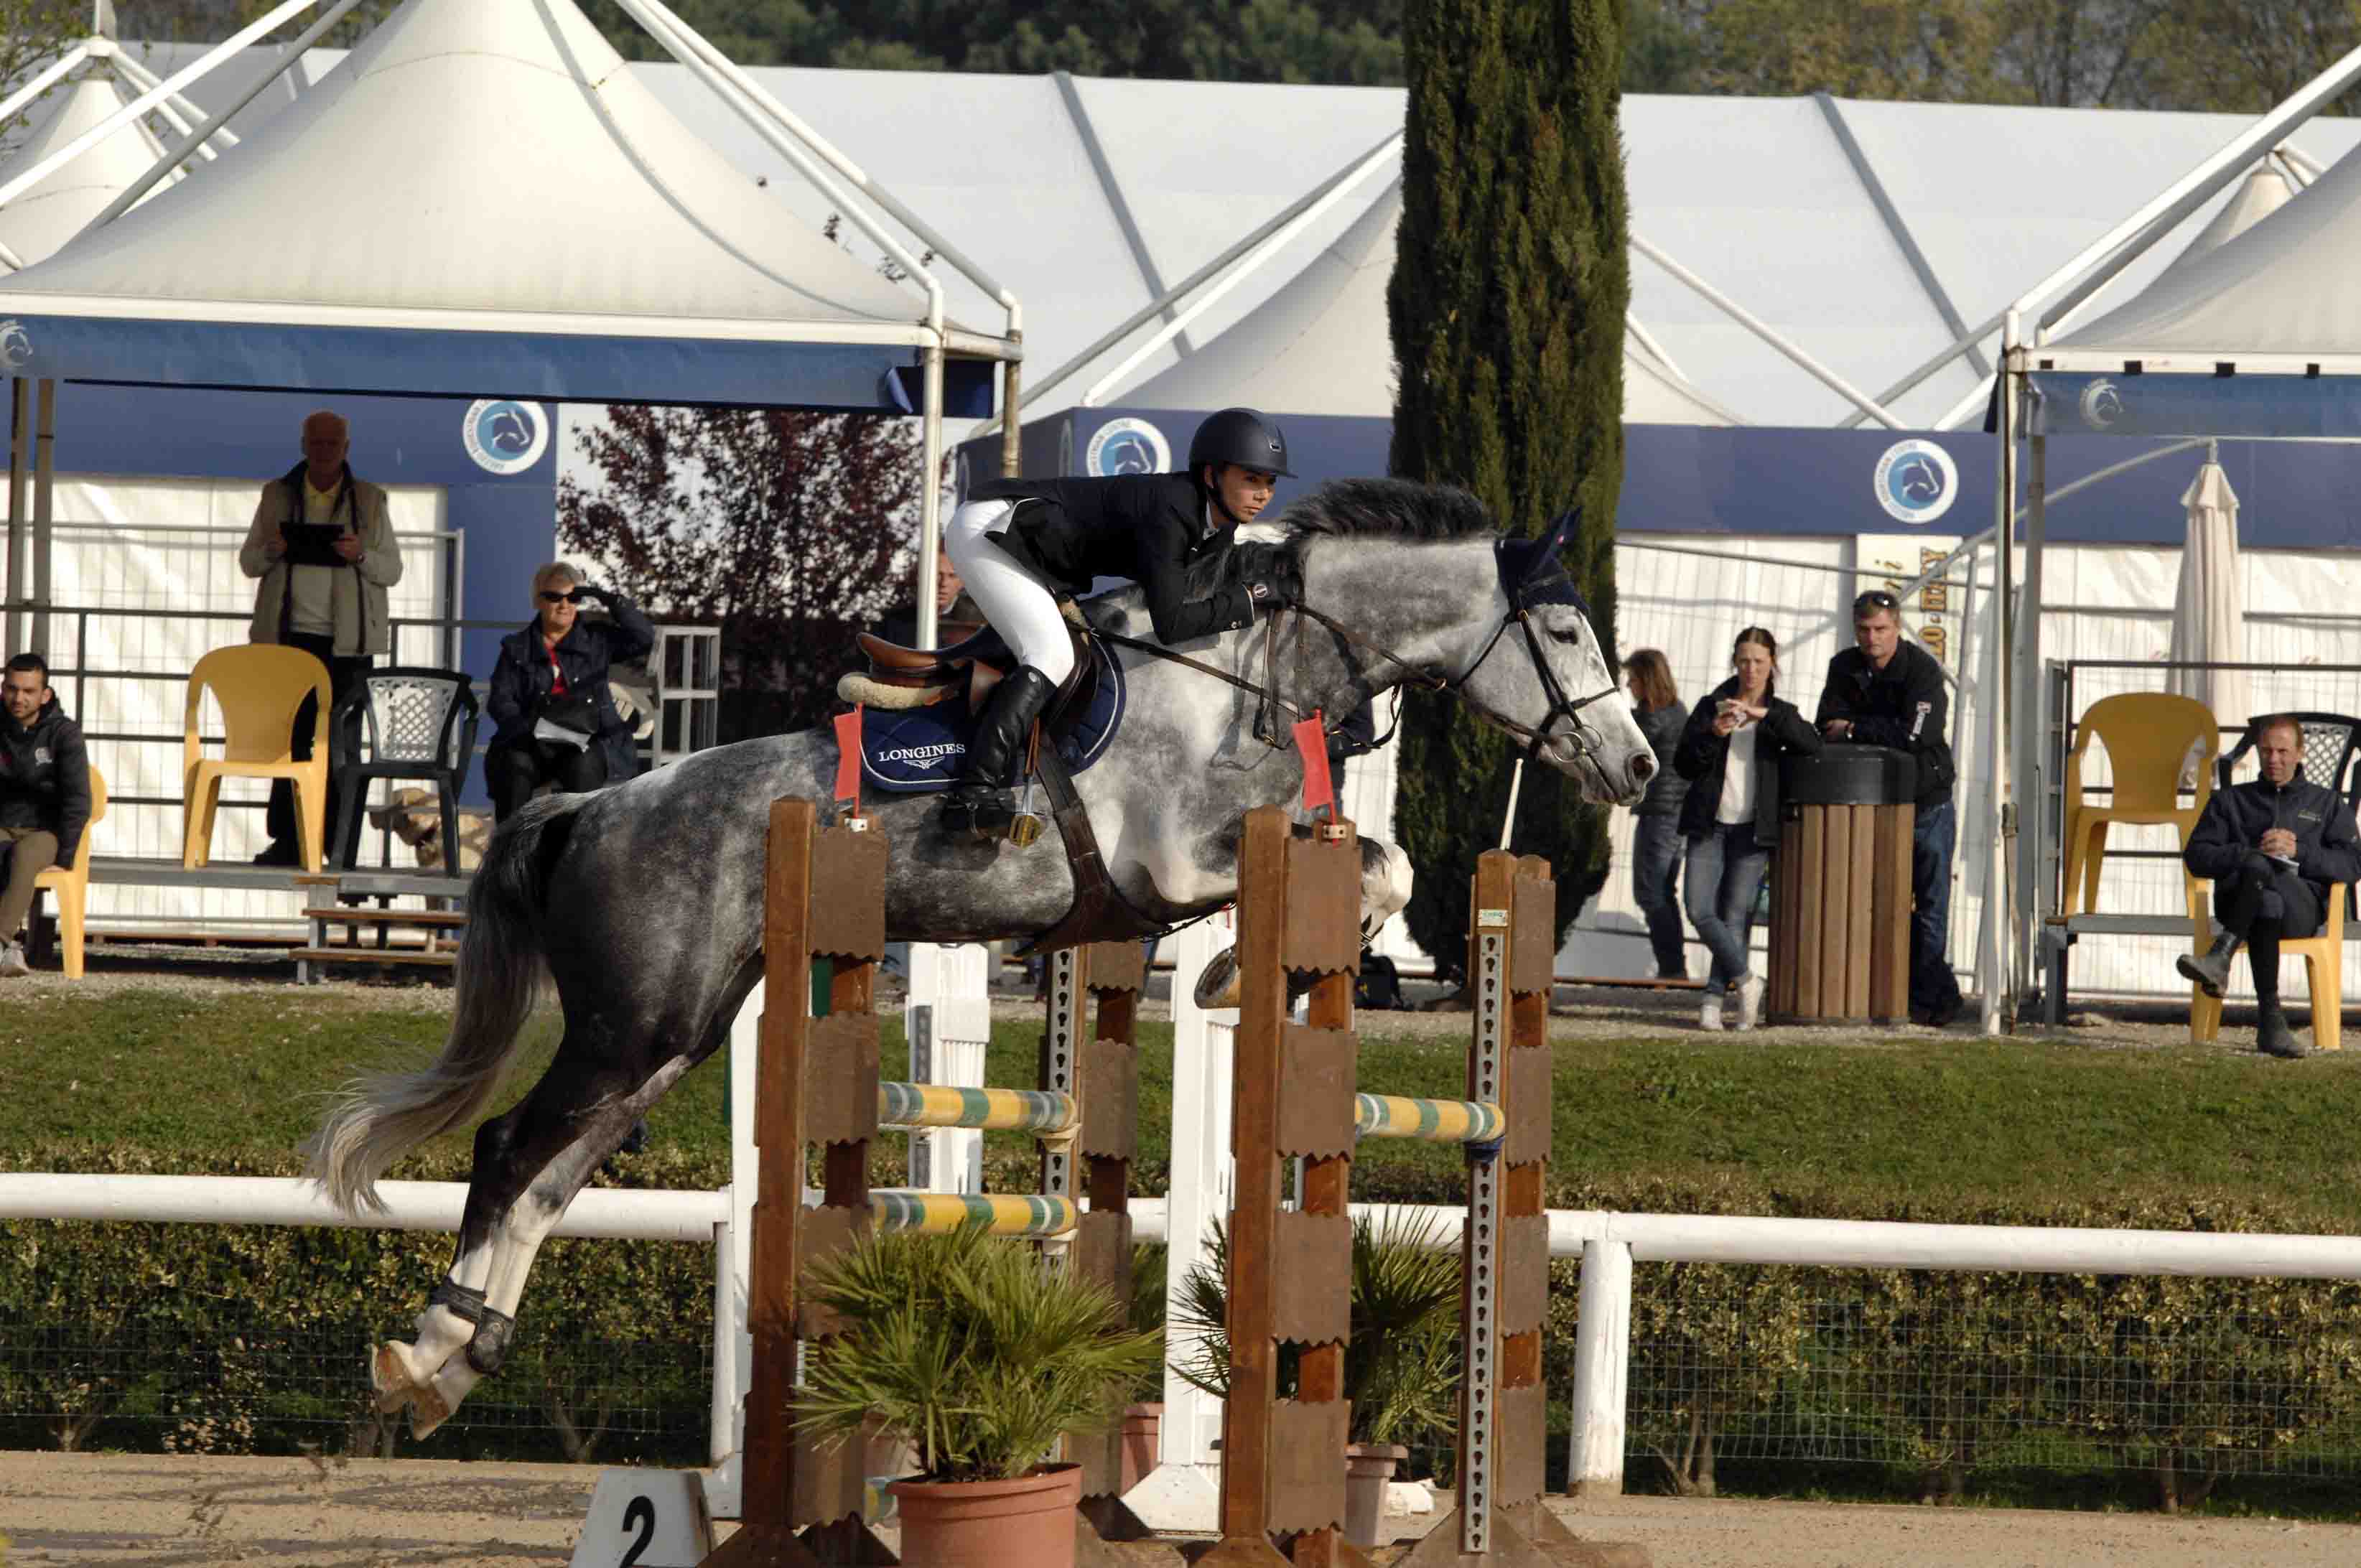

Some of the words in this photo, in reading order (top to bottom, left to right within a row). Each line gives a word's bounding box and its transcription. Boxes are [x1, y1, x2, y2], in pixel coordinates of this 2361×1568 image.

[1920, 547, 1947, 612] ITY
[878, 743, 966, 762] LONGINES
[620, 1495, 656, 1568] 2
